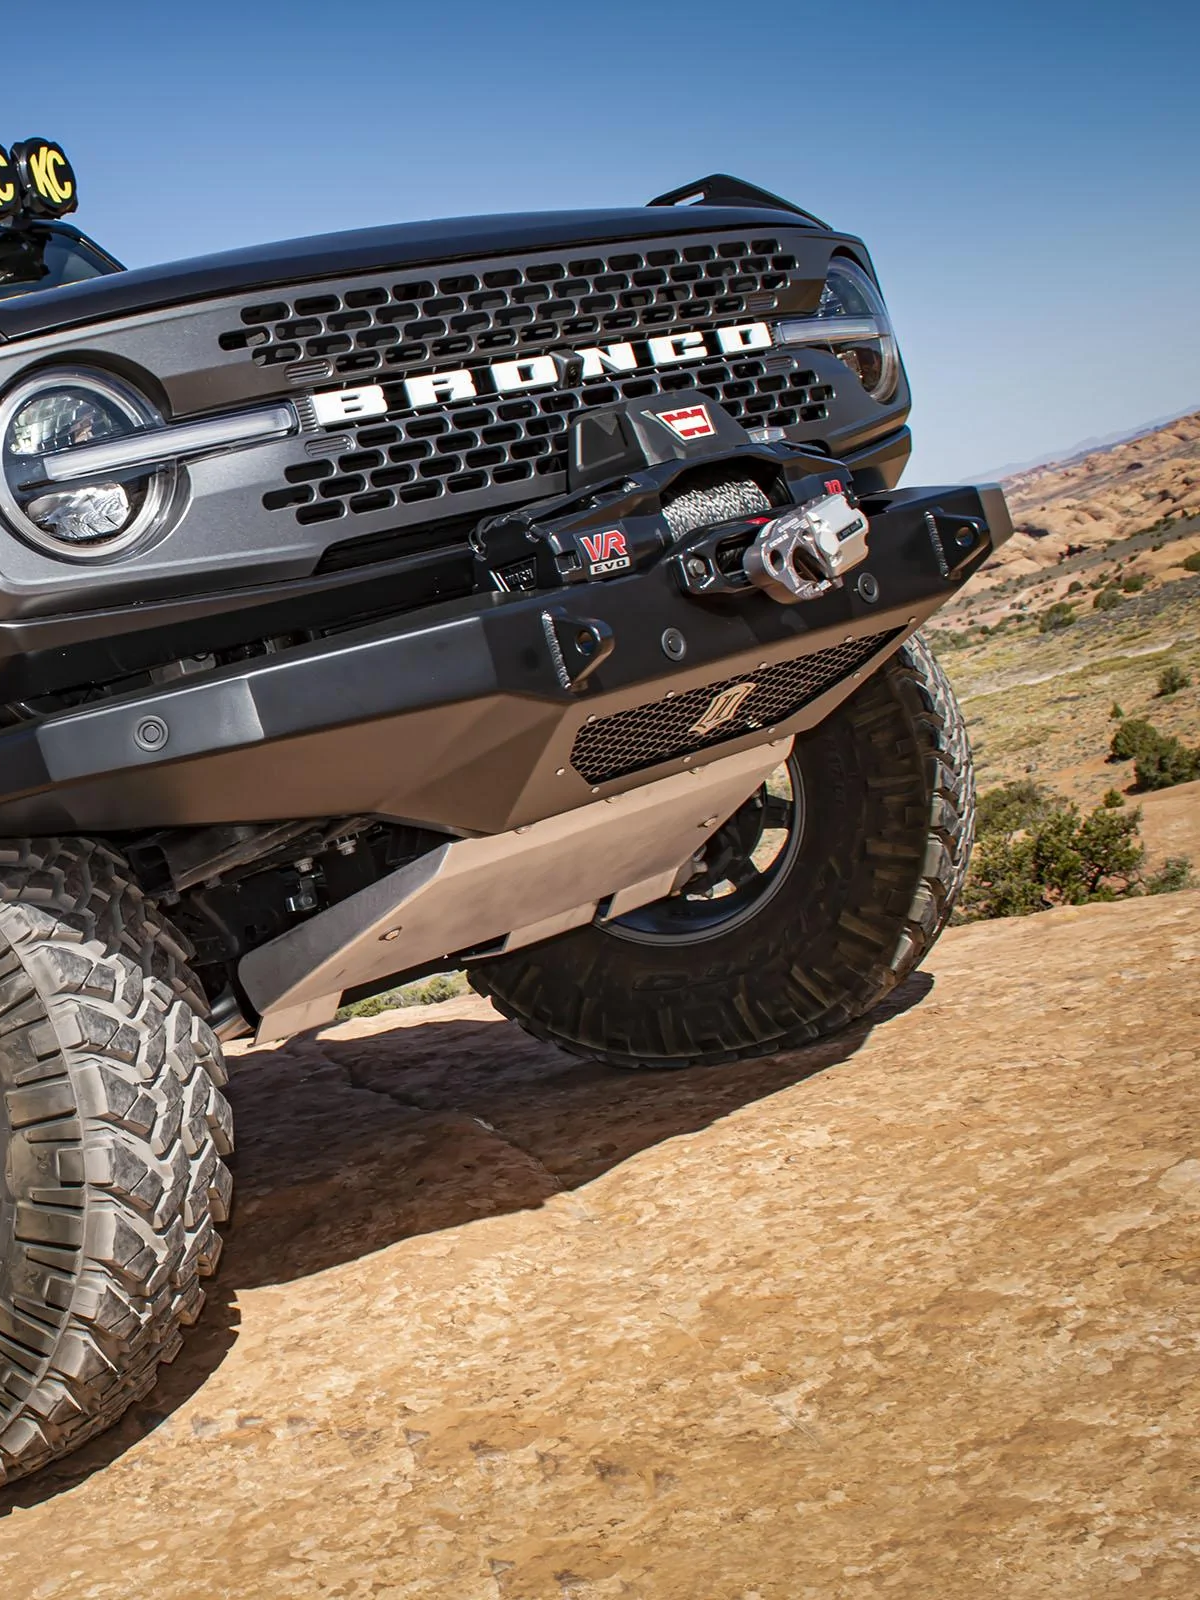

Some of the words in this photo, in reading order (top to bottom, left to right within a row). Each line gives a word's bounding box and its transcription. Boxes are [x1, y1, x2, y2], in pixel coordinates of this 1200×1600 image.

[29, 146, 72, 203] KC
[308, 321, 774, 428] BRONCO
[824, 479, 843, 495] 10
[579, 529, 628, 563] VR
[594, 559, 627, 573] EVO
